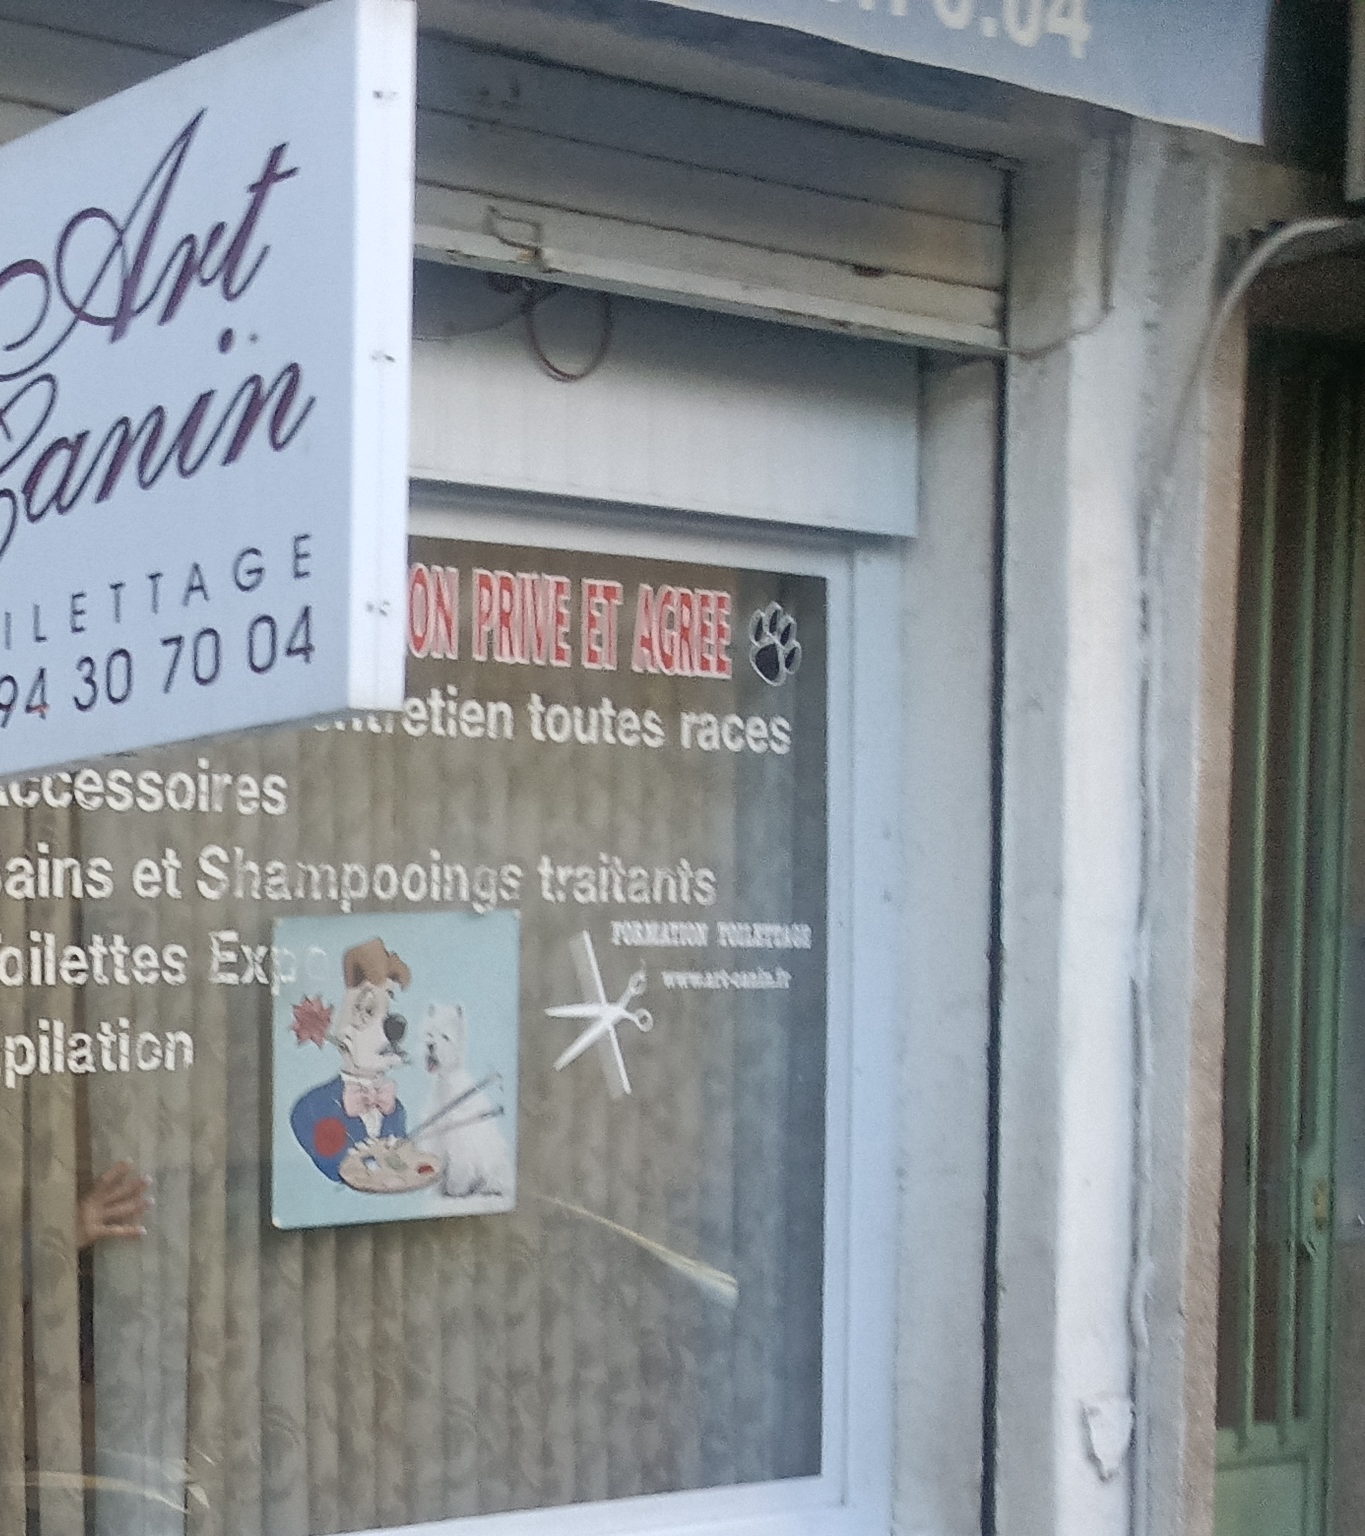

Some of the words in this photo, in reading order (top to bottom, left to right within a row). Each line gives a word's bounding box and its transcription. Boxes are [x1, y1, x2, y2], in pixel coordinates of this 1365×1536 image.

[72, 648, 133, 712] 30
[160, 627, 222, 694] 70
[247, 605, 315, 674] 04
[472, 568, 571, 667] PRIVE
[580, 578, 624, 671] ET
[631, 583, 732, 679] AGREE
[527, 693, 665, 748] toutes
[680, 710, 792, 755] races
[132, 847, 182, 899] et
[196, 844, 523, 915] Shampooings
[537, 852, 718, 906] traitants
